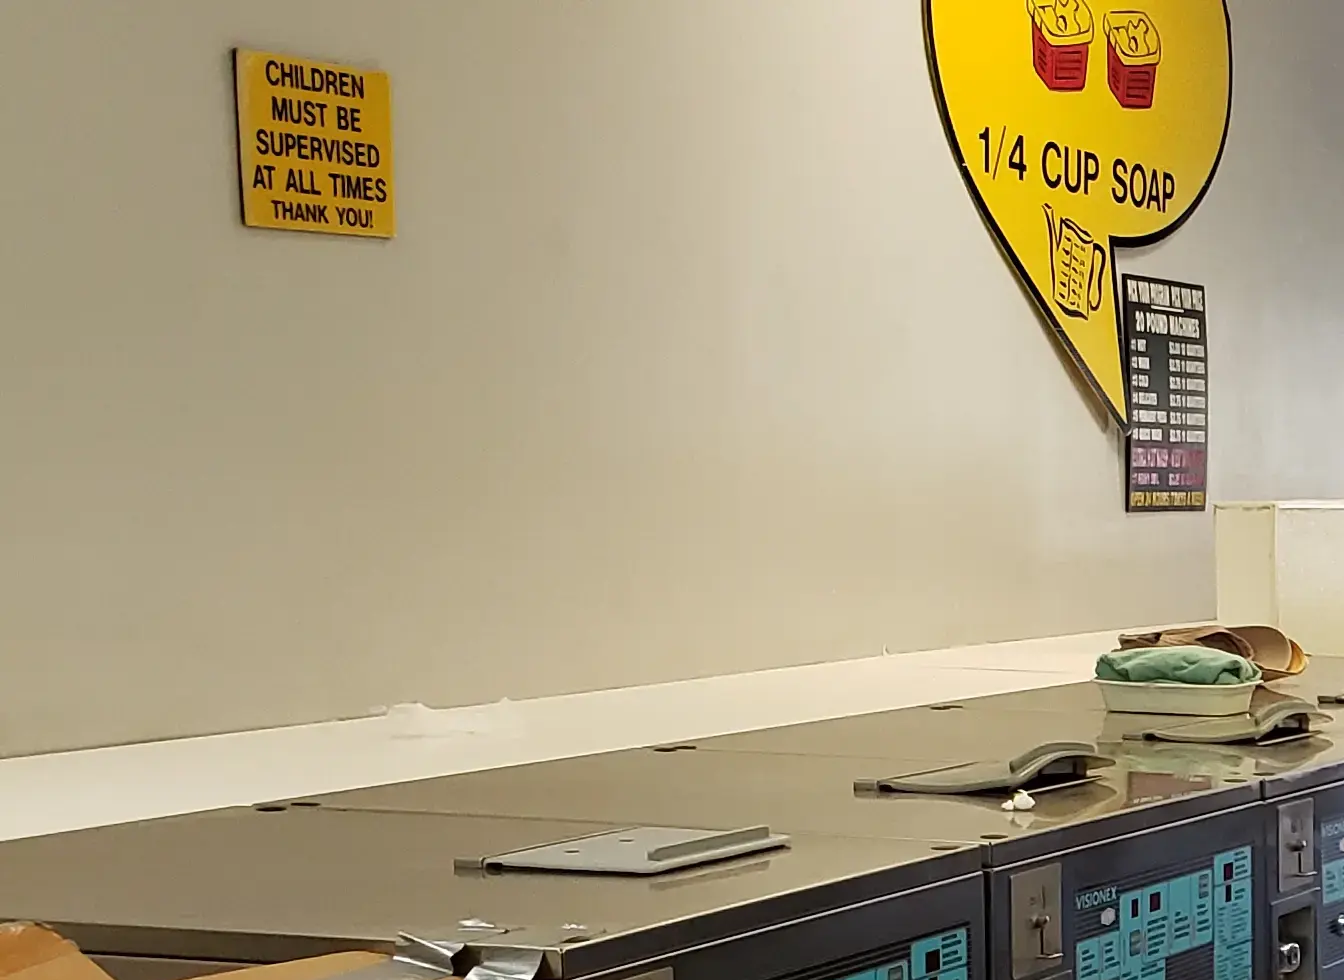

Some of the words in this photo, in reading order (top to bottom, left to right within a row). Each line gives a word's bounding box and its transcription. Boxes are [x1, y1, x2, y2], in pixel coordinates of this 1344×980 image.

[265, 60, 364, 99] CHILDREN
[271, 96, 327, 129] MUST
[337, 106, 362, 133] BE
[256, 129, 380, 168] SUPERVISED
[253, 165, 275, 191] AT
[285, 169, 321, 198] ALL
[329, 172, 387, 203] TIMES
[979, 125, 1027, 181] 1/4
[1041, 141, 1099, 194] CUP
[1111, 159, 1175, 213] SOAP
[271, 200, 329, 225] THANK
[336, 206, 374, 228] YOU!
[1135, 310, 1145, 333] 20
[1146, 312, 1168, 335] POUND
[1076, 885, 1117, 909] VISIONEX
